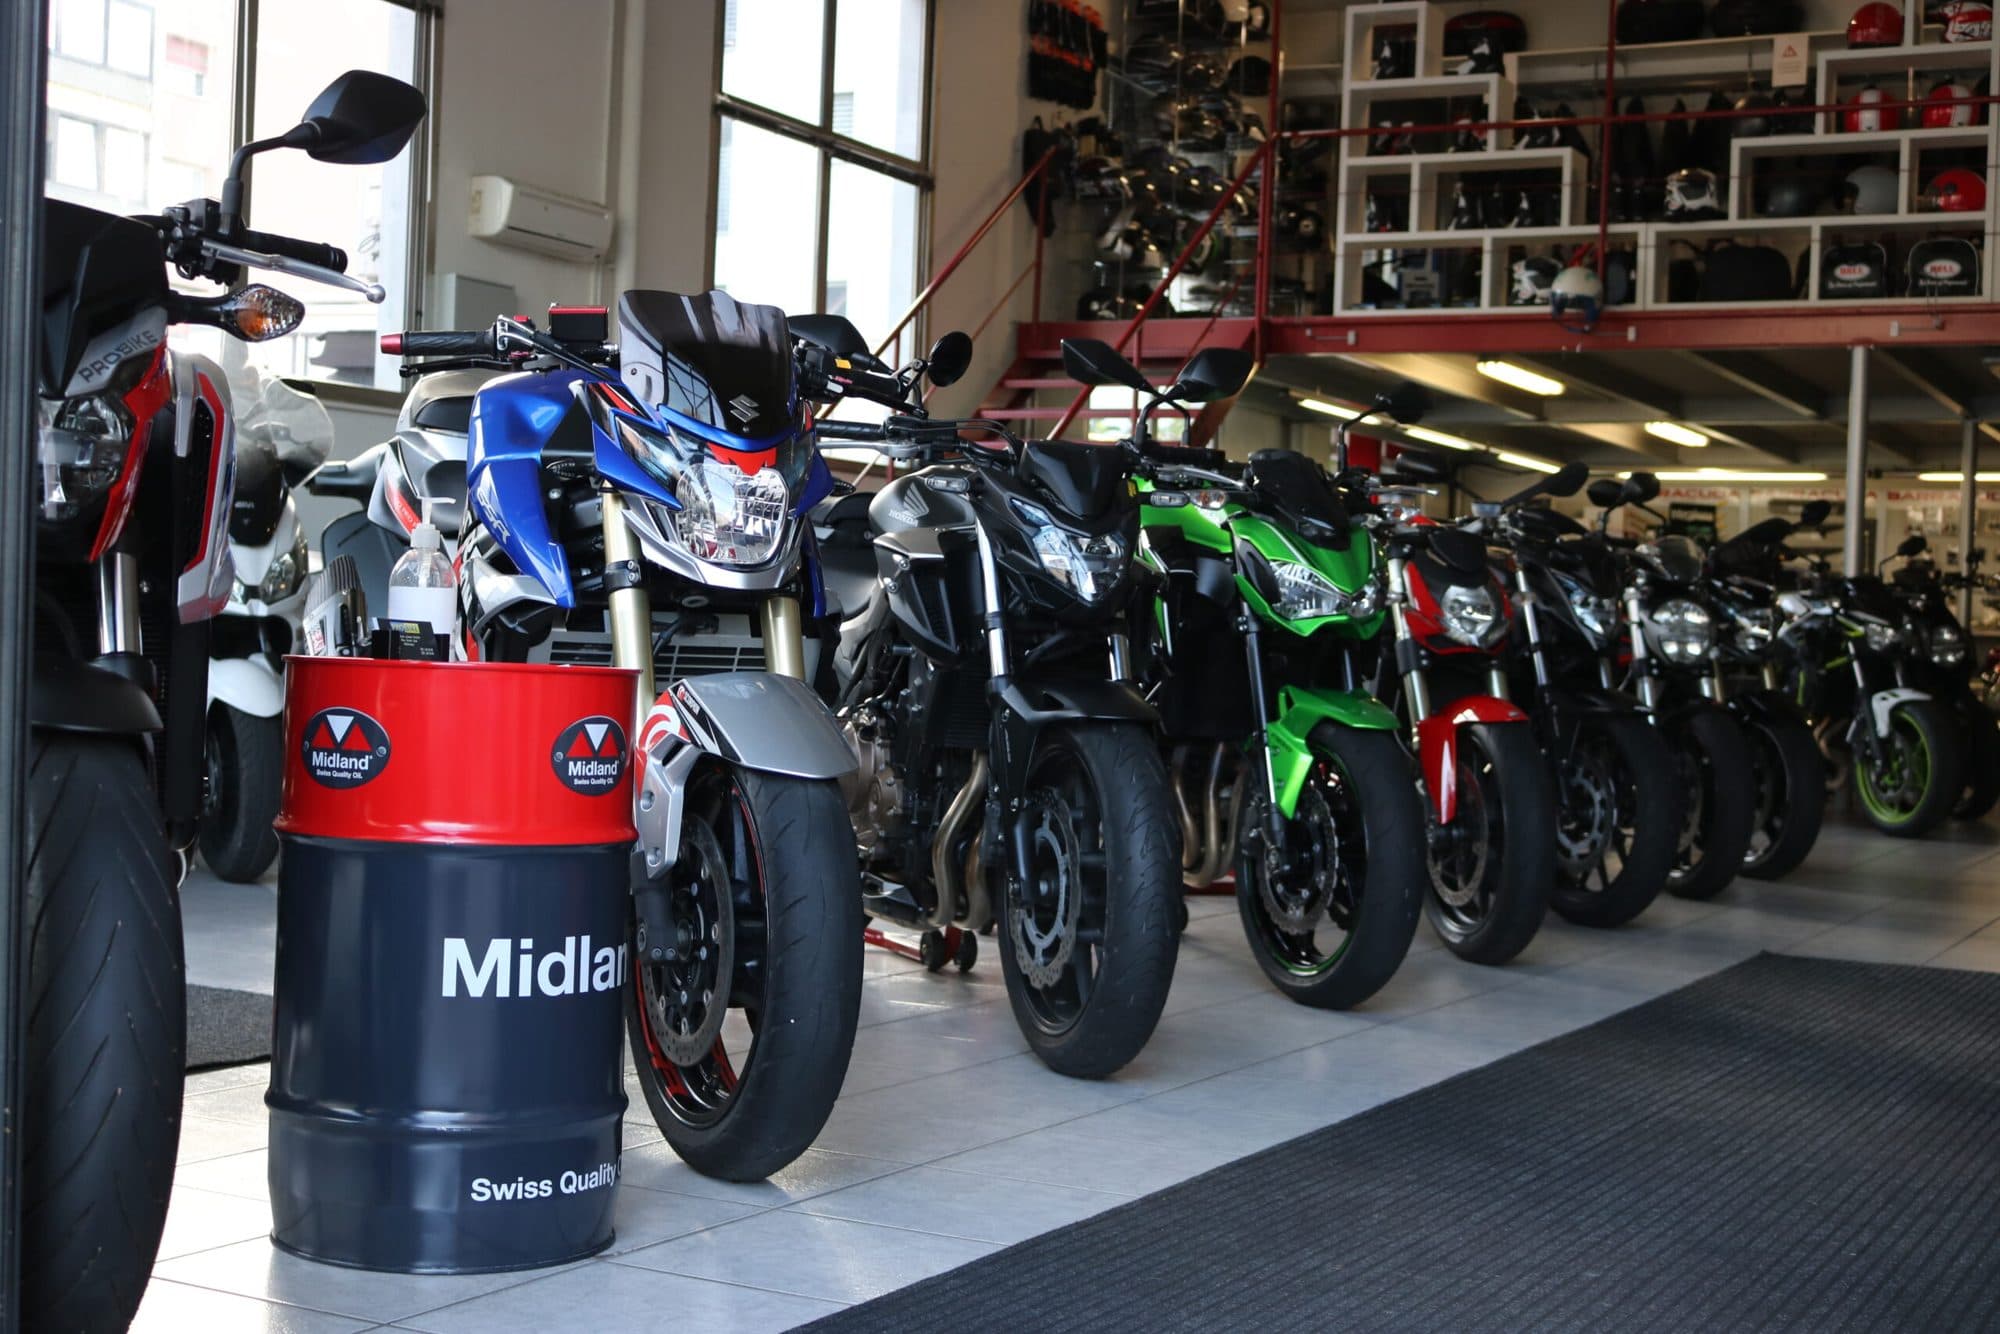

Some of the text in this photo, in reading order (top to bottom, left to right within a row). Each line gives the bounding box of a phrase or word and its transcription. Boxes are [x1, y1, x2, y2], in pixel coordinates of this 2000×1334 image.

[79, 330, 158, 383] PROBIKE
[888, 509, 919, 528] HONDA
[312, 751, 369, 770] Midland
[568, 760, 618, 776] Midland
[471, 1178, 553, 1201] Swiss
[560, 1163, 617, 1194] Quality
